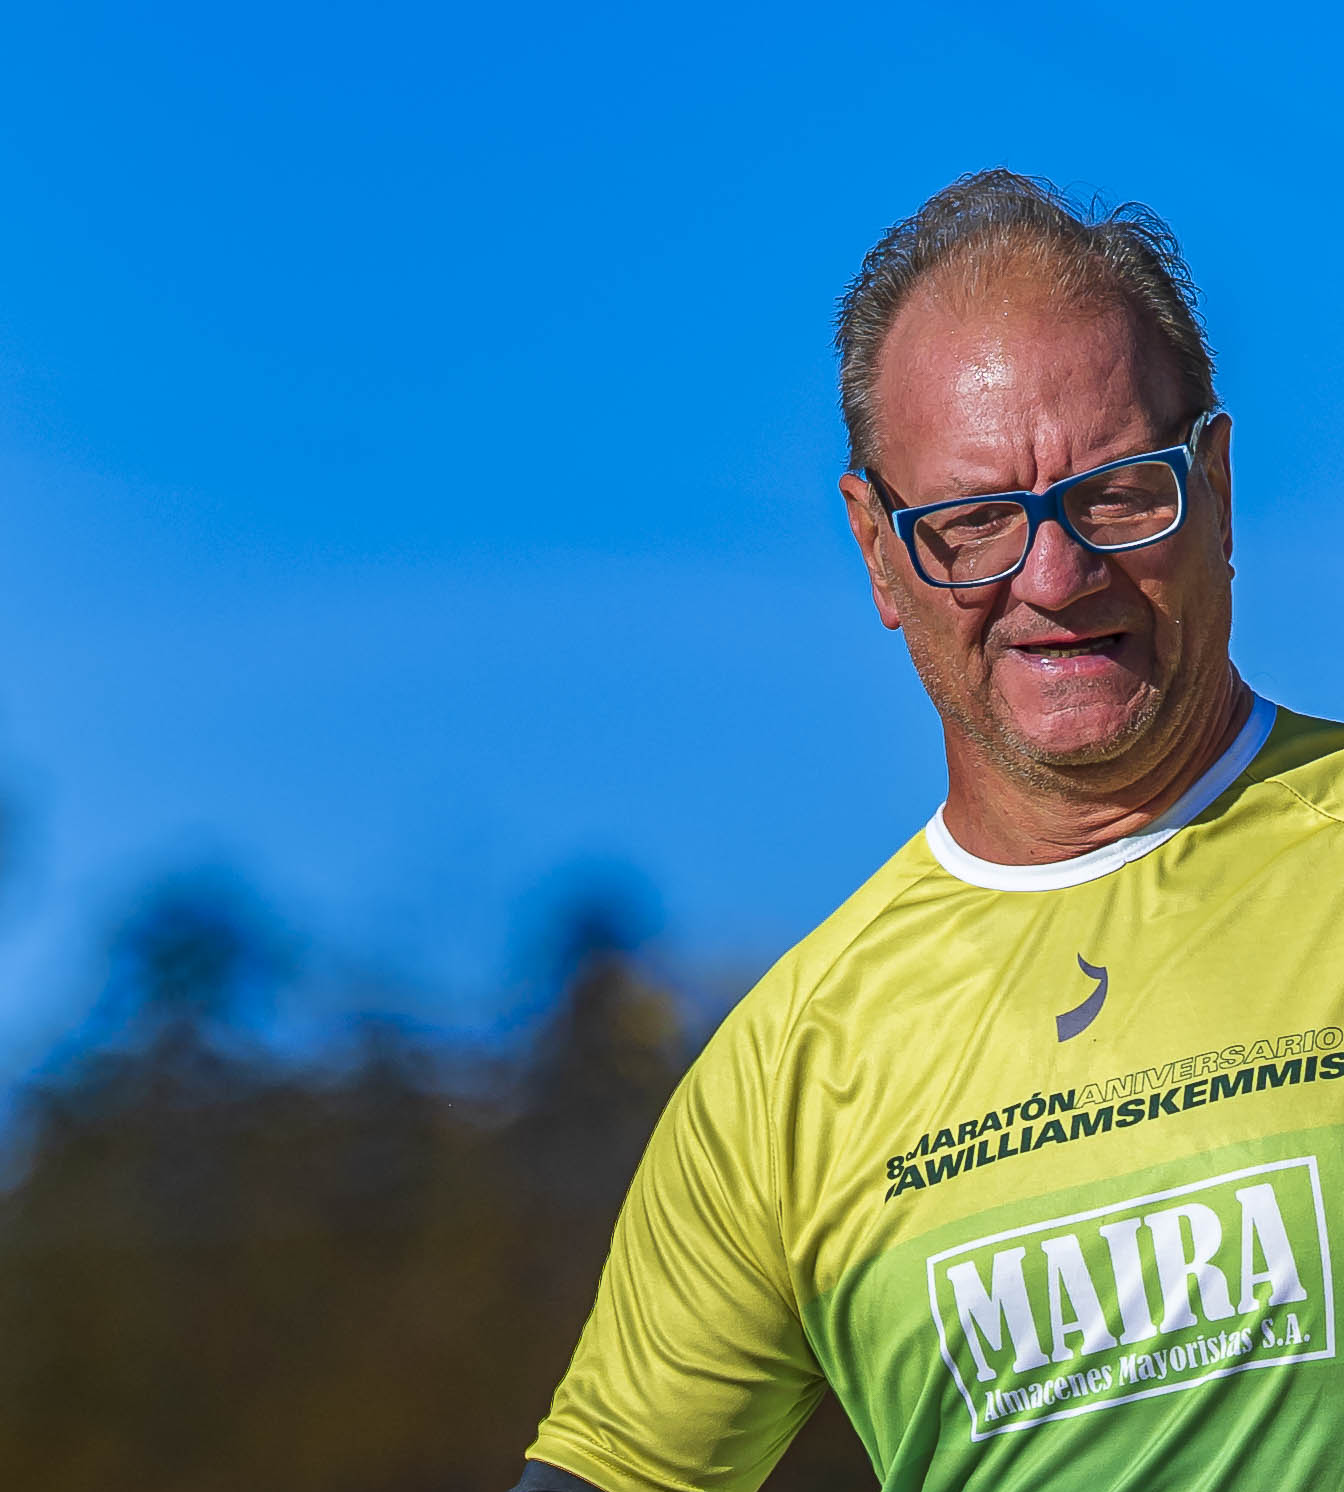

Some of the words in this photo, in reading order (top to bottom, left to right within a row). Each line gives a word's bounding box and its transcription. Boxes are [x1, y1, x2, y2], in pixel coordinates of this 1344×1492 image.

[946, 1183, 1308, 1383] MAIRA
[983, 1361, 1114, 1423] Almacenes
[1118, 1325, 1253, 1387] Mayoristas
[1261, 1313, 1311, 1349] S.A.
